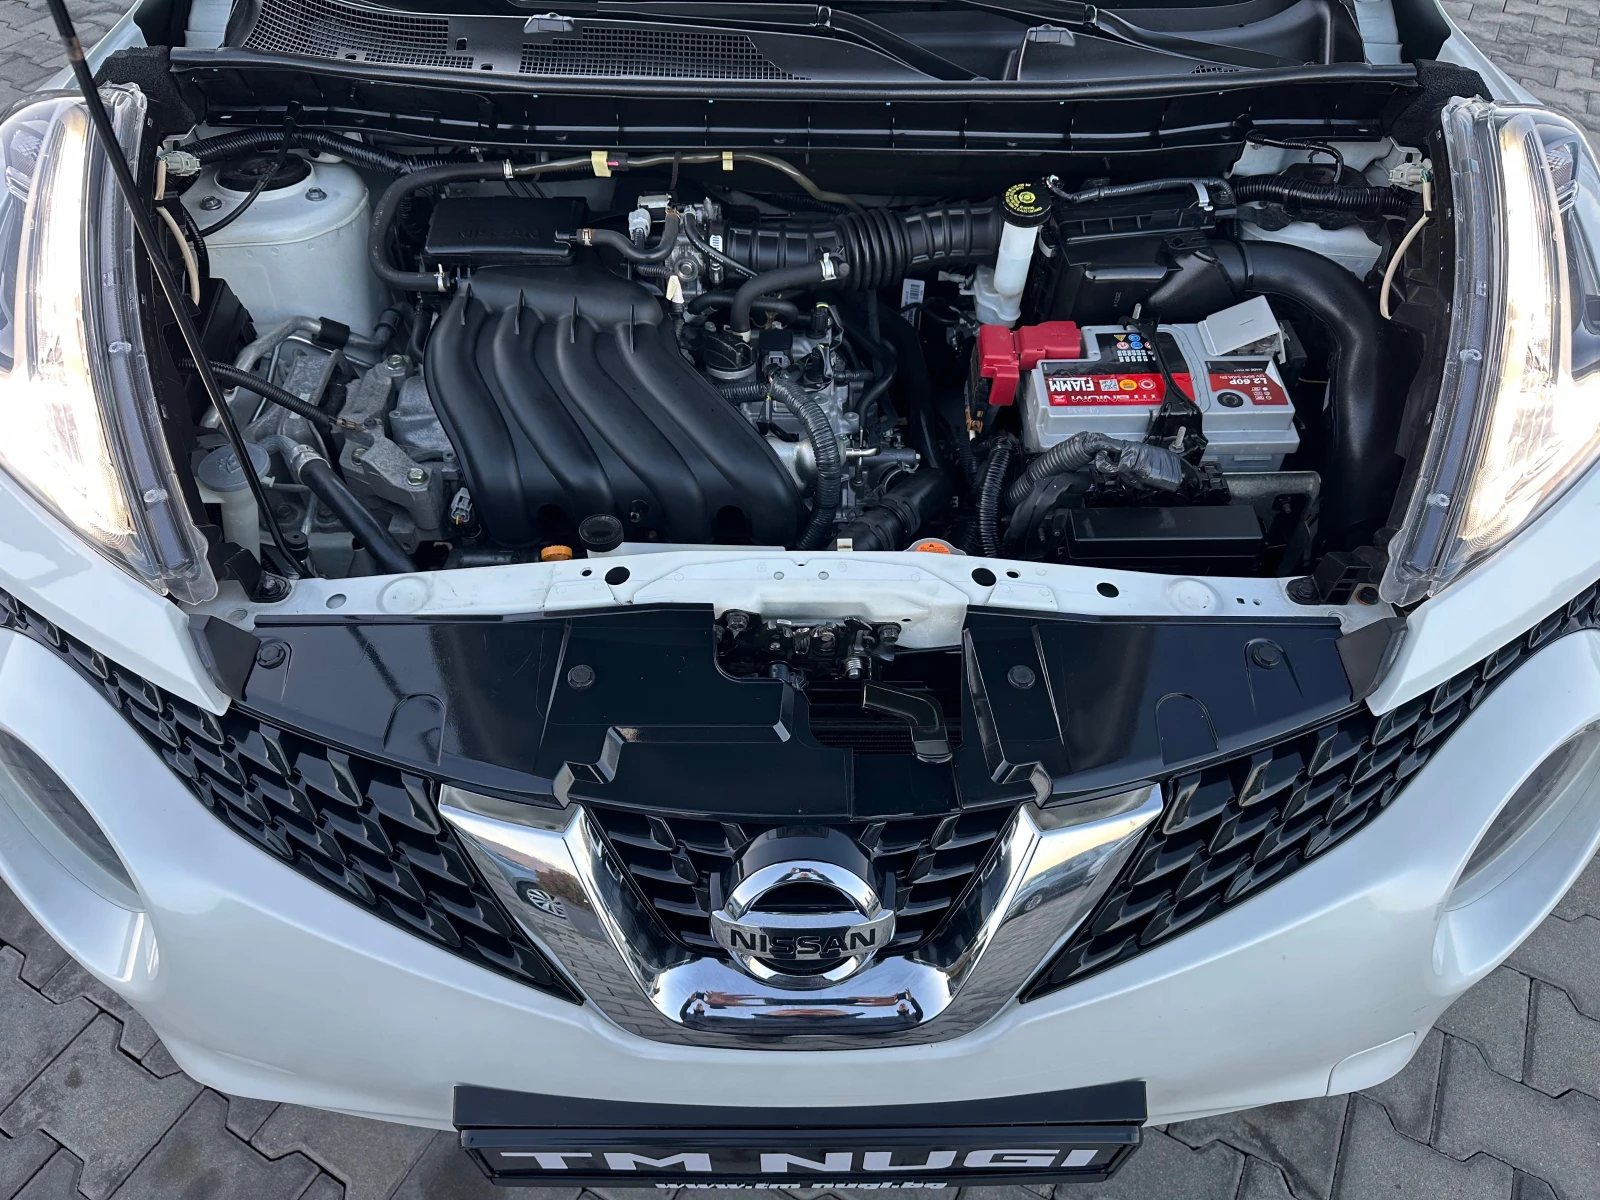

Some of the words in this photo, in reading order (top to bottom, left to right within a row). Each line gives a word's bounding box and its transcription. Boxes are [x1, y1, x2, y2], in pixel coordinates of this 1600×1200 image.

[458, 227, 540, 240] NISSAN
[1048, 379, 1095, 392] FIAMM
[730, 928, 876, 955] NISSAN
[500, 1152, 712, 1172] TM
[760, 1149, 1099, 1173] NUGI
